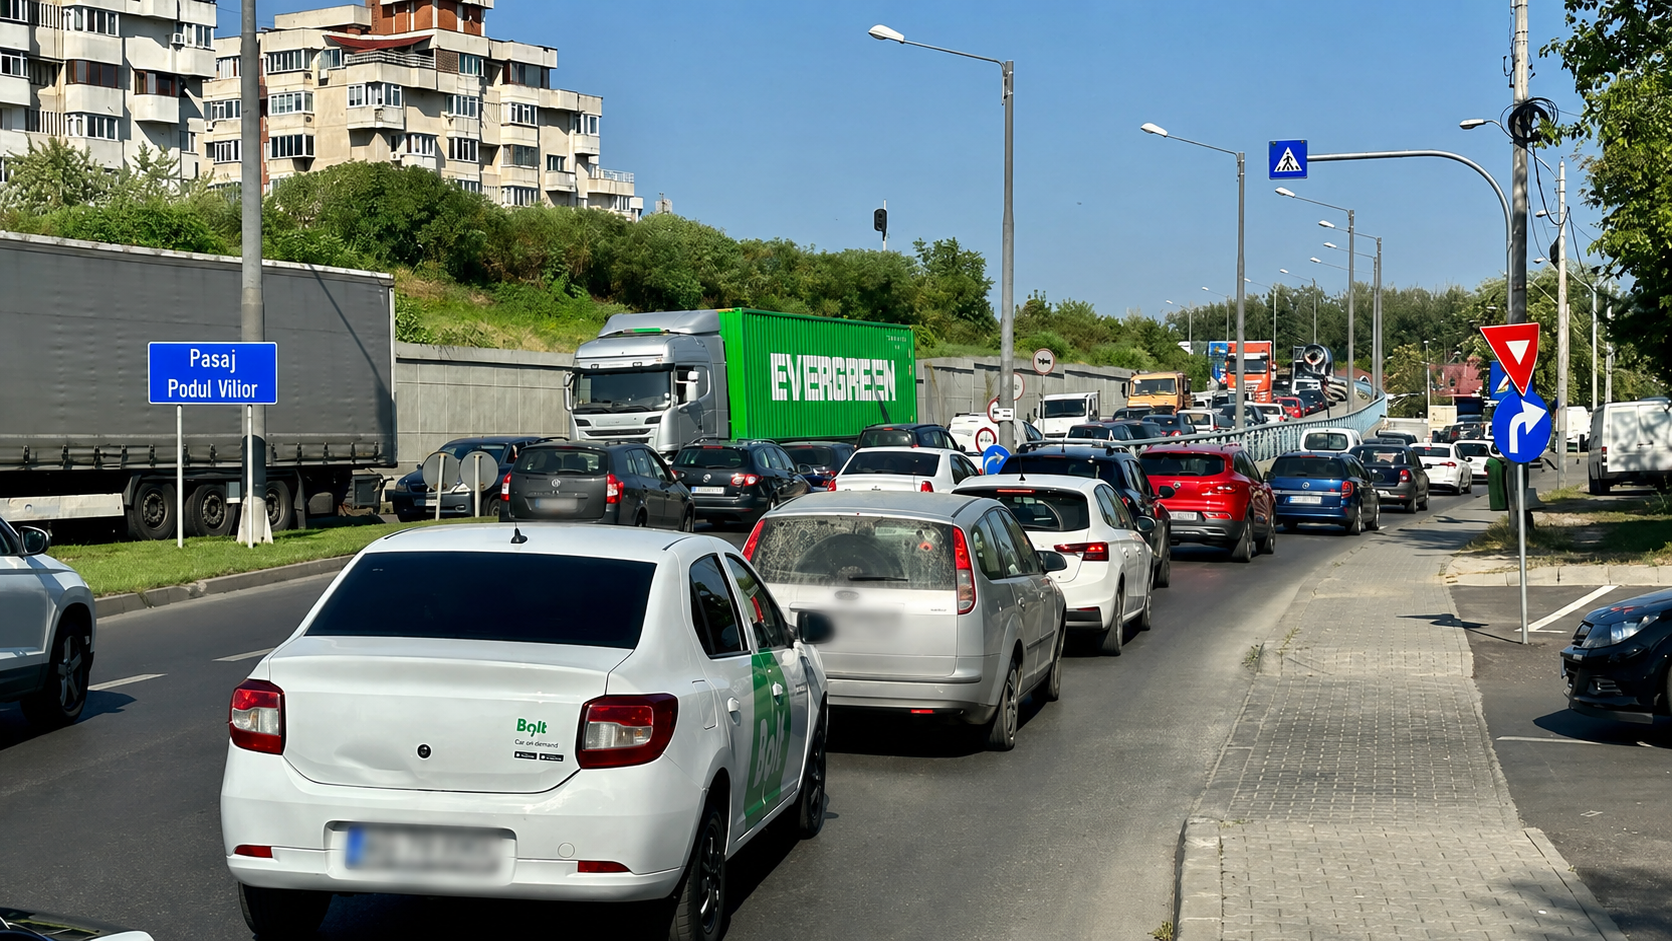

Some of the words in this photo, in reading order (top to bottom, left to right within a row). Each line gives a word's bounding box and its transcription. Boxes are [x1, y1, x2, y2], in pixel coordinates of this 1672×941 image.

[190, 348, 236, 374] Pasaj
[168, 378, 212, 398] Podul
[218, 379, 258, 398] Vilior
[769, 352, 897, 402] EVERGREEN
[517, 718, 547, 737] Bolt
[534, 741, 559, 749] demand
[752, 710, 787, 789] Bolt
